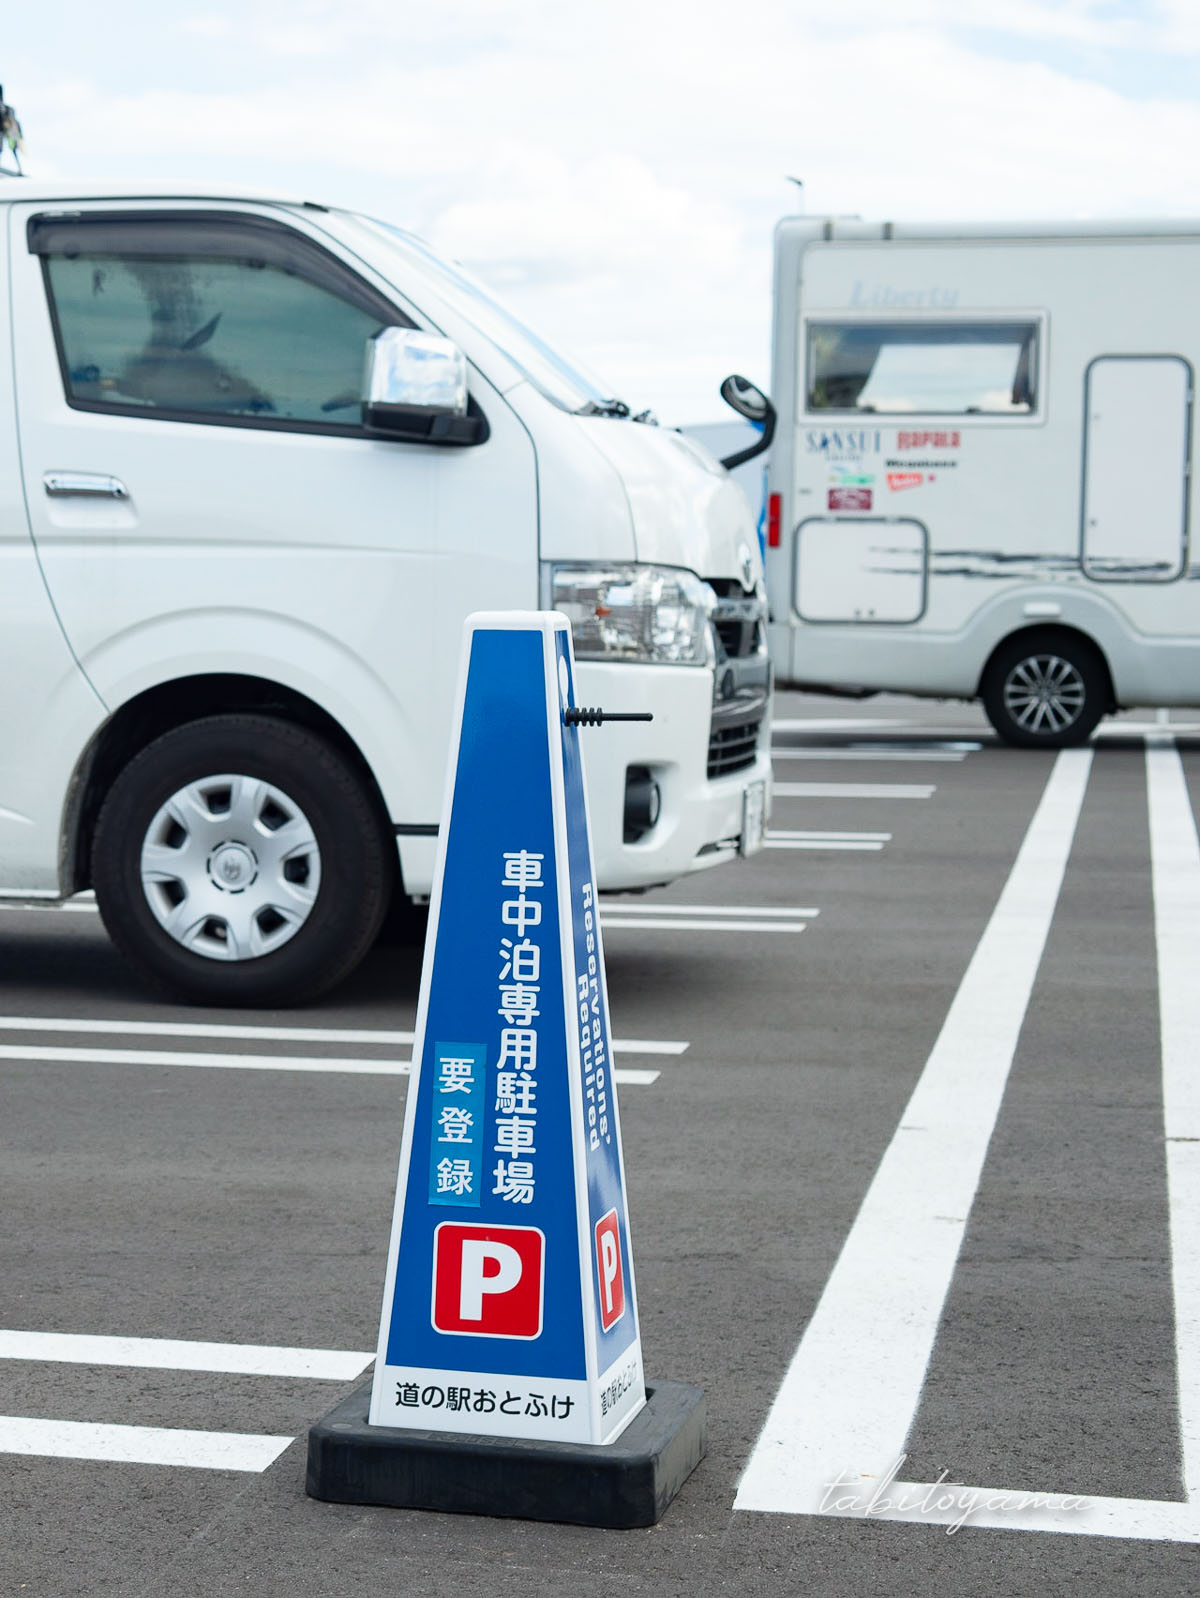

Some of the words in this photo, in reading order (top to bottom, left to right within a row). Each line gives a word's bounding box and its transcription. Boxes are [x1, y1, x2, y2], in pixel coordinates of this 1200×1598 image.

[491, 849, 544, 1204] 車中泊専用駐車場
[577, 973, 600, 1152] Required
[436, 1056, 475, 1197] 要登録
[459, 1239, 523, 1321] P
[600, 1229, 617, 1314] P
[395, 1381, 575, 1419] 道の駅おとふけ
